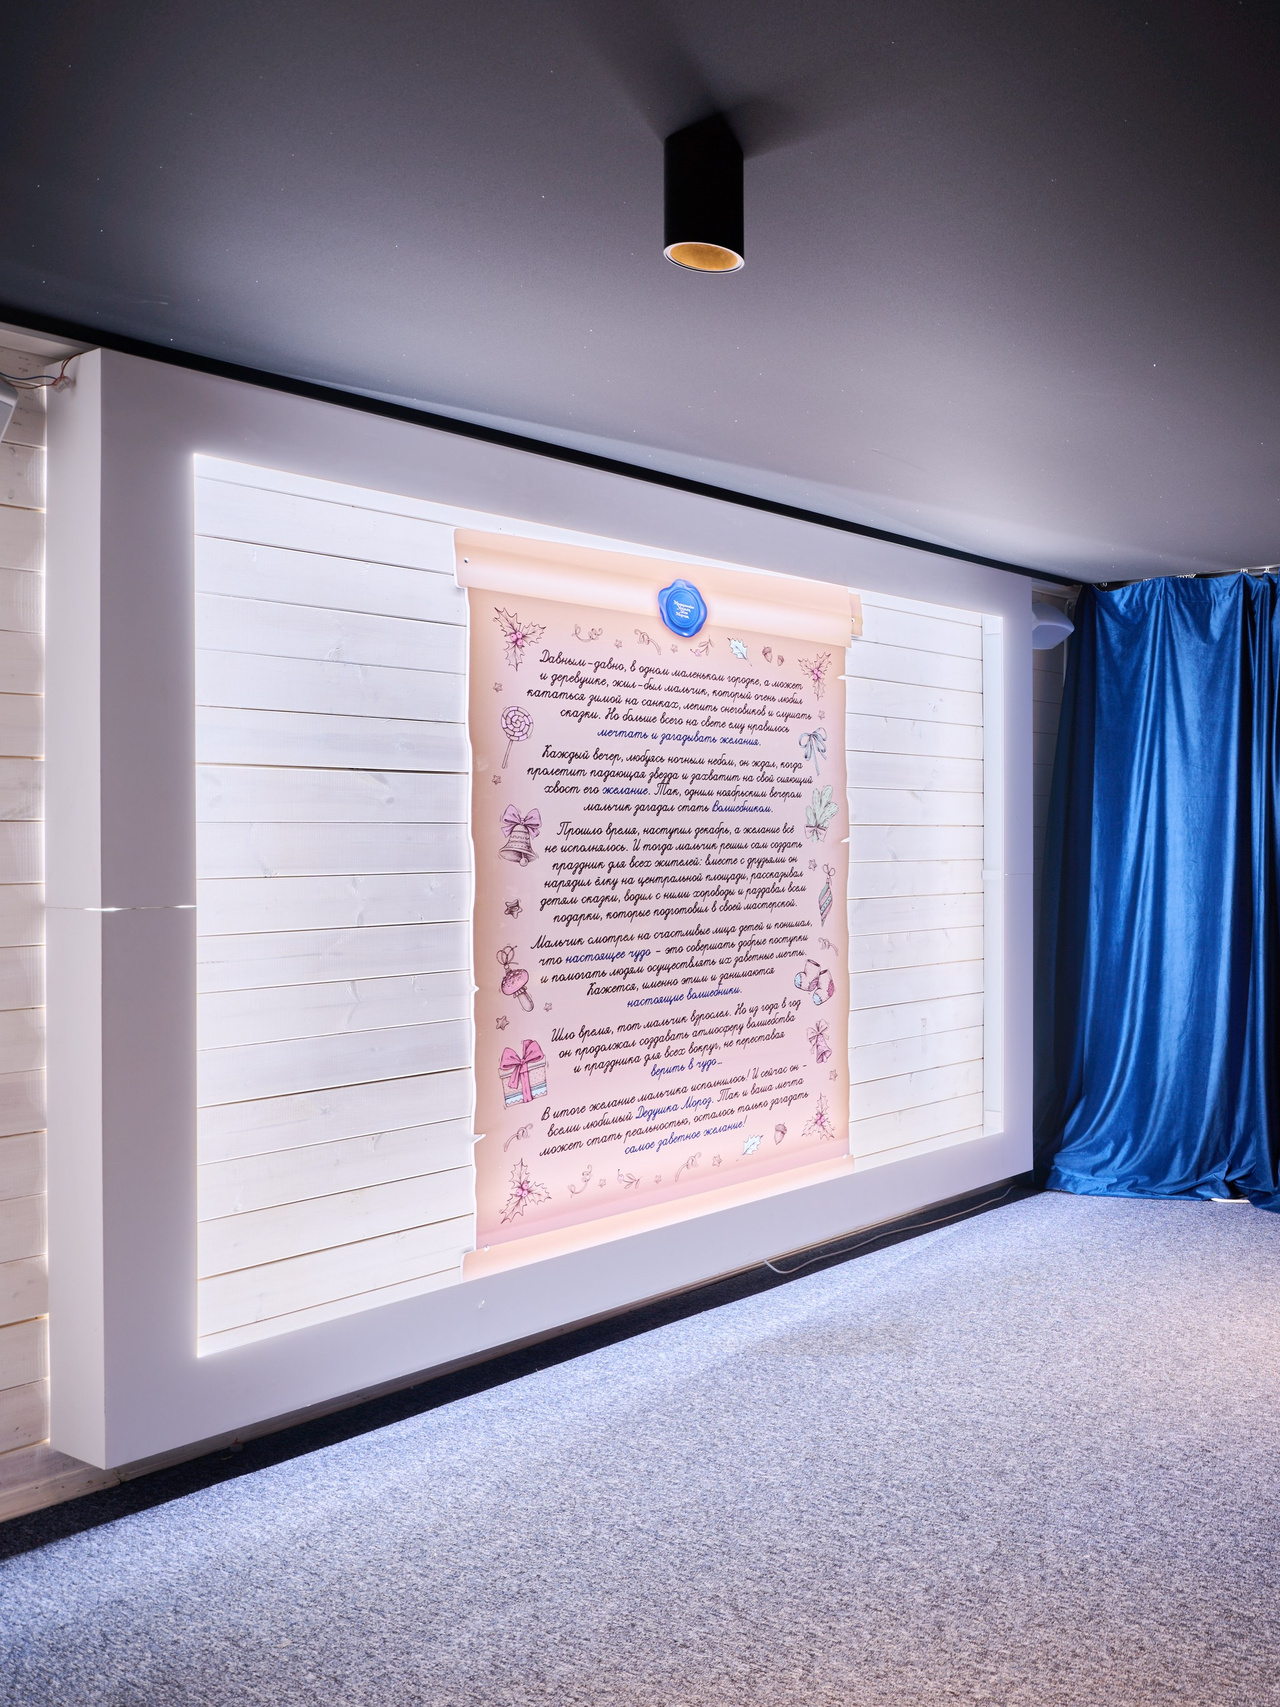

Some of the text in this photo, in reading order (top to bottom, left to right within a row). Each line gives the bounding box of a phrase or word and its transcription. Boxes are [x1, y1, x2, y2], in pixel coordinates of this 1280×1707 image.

[550, 670, 608, 689] деревушке,
[663, 685, 709, 696] мальчик,
[711, 689, 752, 702] который
[753, 693, 776, 702] очень
[777, 692, 803, 704] любил
[638, 665, 669, 678] одном
[671, 669, 725, 681] маленьком
[726, 675, 761, 688] городке,
[771, 681, 803, 690] может
[526, 688, 811, 722] кататься зимой санках, лепить снеговиков слушать
[559, 706, 789, 734] сказки. Но больше всего свете ему нравилось
[596, 729, 760, 746] мечтать загадывать желания.
[541, 744, 803, 773] Каждый вечер, любуясь ночным небом, ждал, когда
[526, 766, 813, 786] пролетит падающая звезда захватит свой сияющий
[543, 779, 802, 802] хвост его желание. Так, одним ноябрьским вечером
[582, 799, 773, 816] мальчик загадал стать Волшебником.
[556, 821, 794, 840] Прошло время, наступил декабрь, желание всё
[560, 841, 802, 855] исполнялось. тогда мальчик решил сам создать
[551, 853, 786, 875] праздник для всех жителей: вместе друзьями
[543, 866, 803, 893] нарядил ёлку центральной площади, рассказывал
[539, 880, 806, 911] детям сказки, водил ними хороводы раздавал всем
[552, 898, 797, 927] подарки, которые подготовил своей мастерской.
[530, 920, 812, 949] Мальчик смотрел счастливые лица детей понимал,
[538, 933, 808, 965] что настоящее чудо это совершать добрые поступки
[551, 949, 805, 982] помогать людям осуществлять заветные мечты.
[586, 967, 775, 996] Кажется, именно этим занимаются
[626, 985, 742, 1007] настоящие волшебники.
[551, 999, 801, 1043] Шло время, тот мальчик взрослел. Но года год
[574, 1010, 795, 1060] продолжал создавать атмосферу волшебства
[584, 1027, 784, 1076] праздника для всех вокруг, переставая
[650, 1063, 685, 1080] верить
[552, 1066, 787, 1118] итоге желание мальчика исполнилось! сейчас
[546, 1077, 802, 1137] всеми любимый Дедушка Мороз. Так ваша мечта
[539, 1091, 808, 1156] может стать реальностью, осталось только загадать
[624, 1115, 747, 1154] самое заветное желание!
